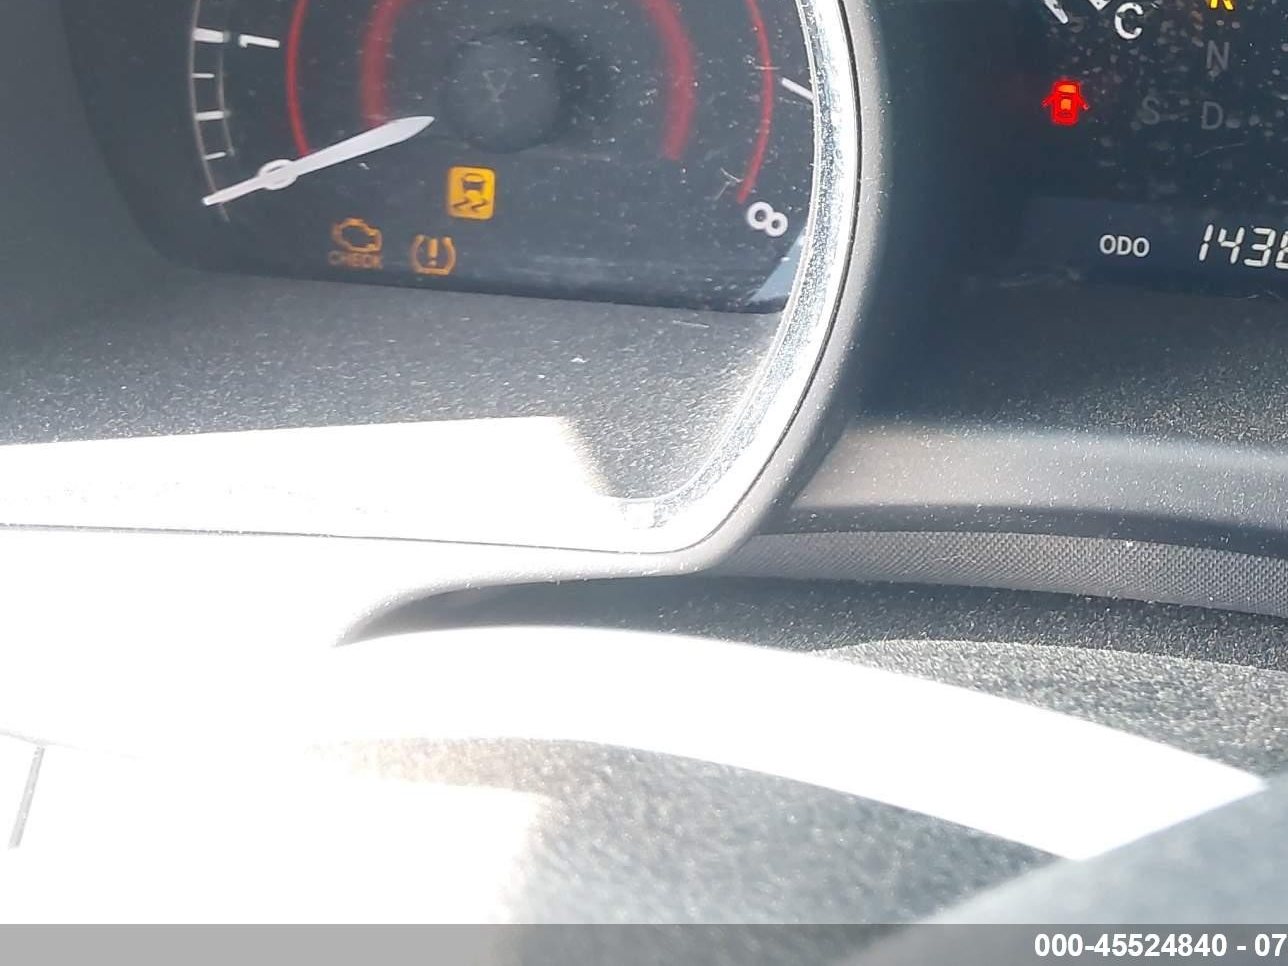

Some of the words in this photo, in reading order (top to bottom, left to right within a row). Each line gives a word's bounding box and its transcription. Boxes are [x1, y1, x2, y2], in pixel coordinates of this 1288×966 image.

[1115, 2, 1143, 39] C
[238, 34, 280, 50] 1
[1206, 40, 1230, 70] N
[1201, 101, 1223, 130] D
[747, 202, 788, 236] 8
[1100, 234, 1149, 257] ODO
